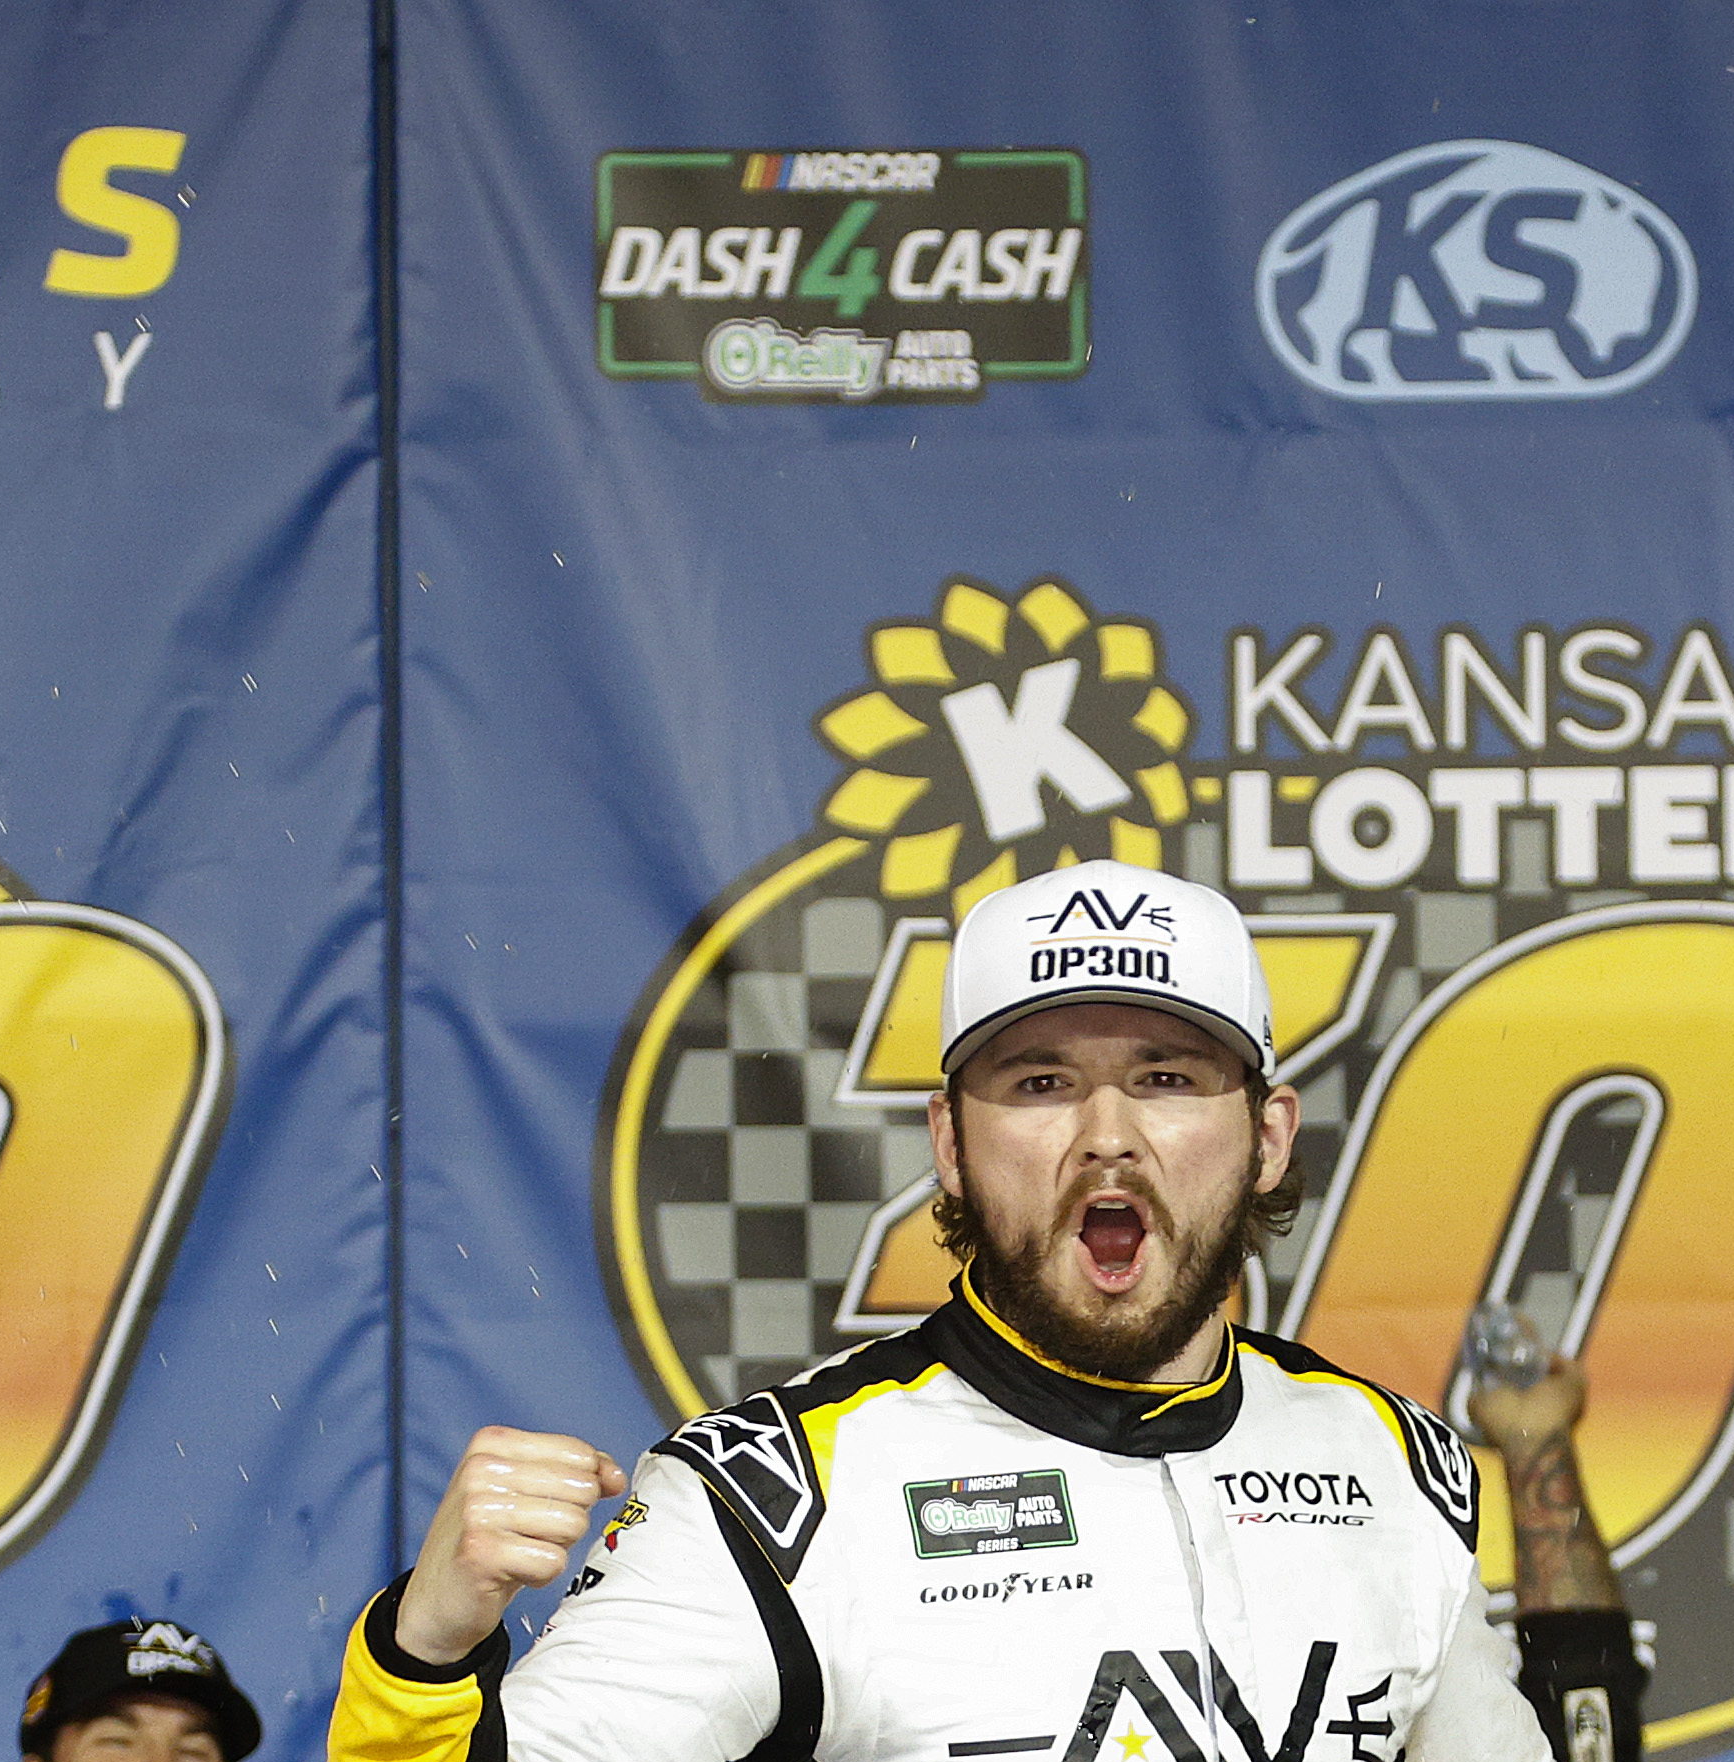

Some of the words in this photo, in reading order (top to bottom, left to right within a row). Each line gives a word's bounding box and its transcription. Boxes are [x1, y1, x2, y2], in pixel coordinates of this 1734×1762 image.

[789, 152, 941, 193] NASCAR
[599, 226, 803, 298] DASH
[795, 200, 883, 318] 4
[888, 228, 1082, 299] CASH
[711, 326, 885, 393] O'Reilly
[888, 358, 981, 391] PARTS
[940, 656, 1132, 842] K
[1031, 945, 1178, 987] OP300
[967, 1474, 1018, 1492] NASCAR
[1214, 1471, 1373, 1508] TOYOTA
[924, 1500, 1012, 1533] O'Reilly
[1015, 1509, 1064, 1528] PARTS
[1017, 1495, 1056, 1512] AUTO
[1225, 1512, 1375, 1527] RACING
[976, 1537, 1019, 1553] SERIES
